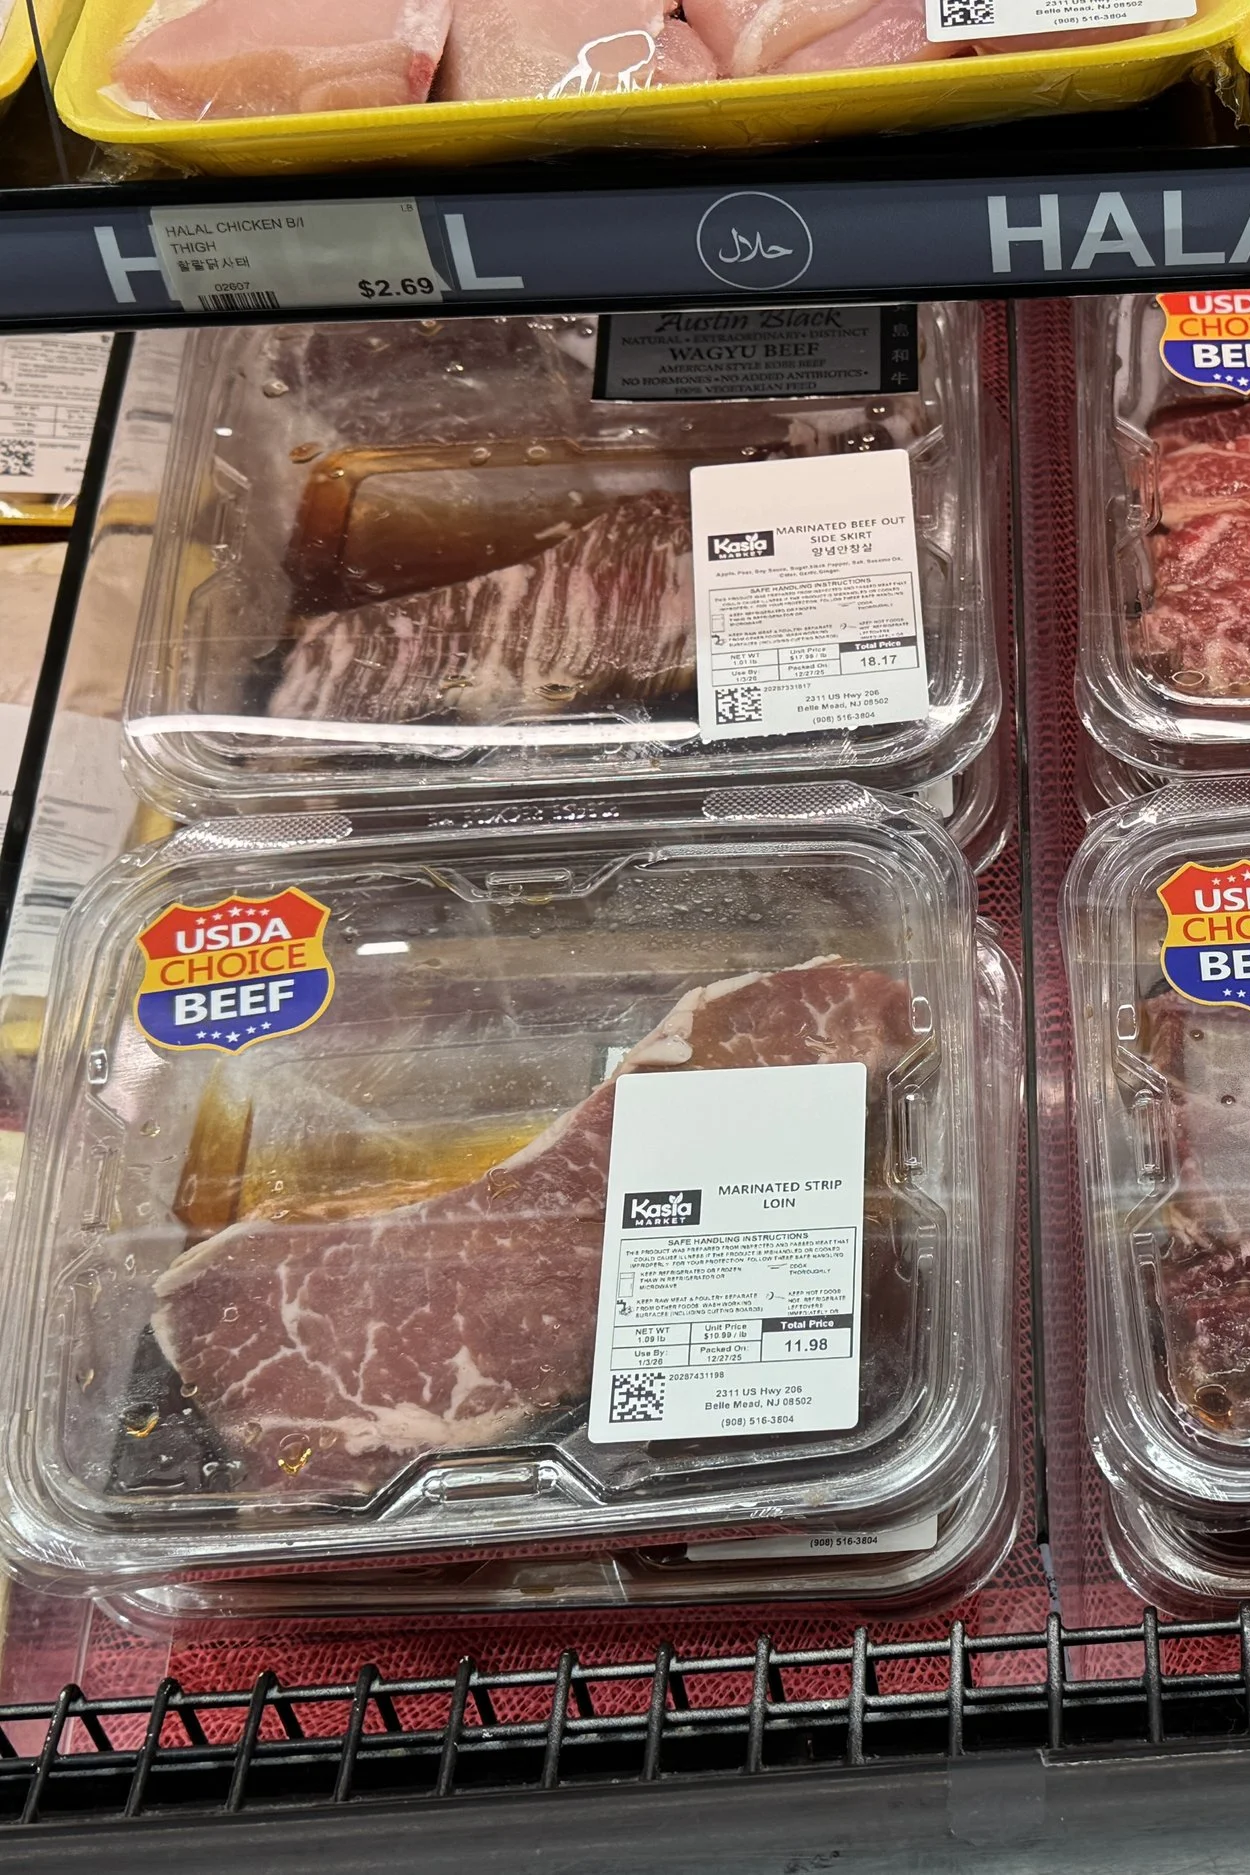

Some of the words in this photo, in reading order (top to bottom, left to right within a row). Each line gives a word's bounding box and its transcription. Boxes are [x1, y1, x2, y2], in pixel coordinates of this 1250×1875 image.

[166, 223, 214, 238] HALAL
[216, 217, 283, 233] CHICKEN
[401, 204, 414, 213] LB
[170, 241, 216, 255] THIGH
[214, 281, 251, 292] 02607
[358, 276, 435, 299] $2.69
[654, 311, 750, 334] Austin
[760, 308, 844, 329] Black
[621, 335, 682, 346] NATURAL
[809, 328, 869, 338] DISTINCT
[669, 346, 757, 363] WAGYU
[764, 342, 820, 357] BEEF
[775, 521, 847, 535] MARINATED
[850, 518, 878, 528] BEEF
[880, 515, 905, 525] OUT
[810, 533, 836, 543] SIDE
[839, 530, 873, 541] SKIRT
[712, 534, 767, 554] Kasia
[854, 641, 878, 651] Total
[878, 639, 901, 649] Price
[859, 654, 897, 667] 18.17
[176, 917, 293, 954] USDA
[160, 943, 307, 986] CHOICE
[174, 979, 295, 1026] BEEF
[717, 1181, 800, 1196] MARINATED
[803, 1179, 842, 1191] STRIP
[630, 1195, 693, 1219] Kasia
[762, 1197, 796, 1209] LOIN
[634, 1216, 686, 1226] MARKET
[667, 1238, 691, 1246] SAFE
[693, 1235, 740, 1245] HANDLING
[742, 1231, 809, 1242] INSTRUCTIONS
[634, 1327, 653, 1335] NET
[655, 1326, 670, 1334] WT
[704, 1323, 724, 1332] Unit
[724, 1322, 747, 1331] Price
[779, 1319, 806, 1330] Total
[808, 1318, 834, 1328] Price
[637, 1335, 655, 1344] 1.09
[656, 1334, 666, 1343] lb
[703, 1331, 732, 1340] $10.99
[738, 1330, 747, 1338] lb
[699, 1344, 733, 1354] Packed
[733, 1344, 750, 1352] On:
[784, 1337, 828, 1353] 11.98
[633, 1349, 651, 1358] Use
[652, 1348, 668, 1358] By:
[706, 1353, 742, 1363] 12/27/25
[637, 1357, 663, 1367] 1/3/26
[715, 1388, 739, 1398] 2311
[741, 1387, 757, 1396] US
[759, 1385, 782, 1396] Hwy
[784, 1384, 803, 1394] 206
[704, 1400, 730, 1410] Belle
[732, 1399, 763, 1409] Mead,
[766, 1398, 780, 1407] NJ
[782, 1396, 812, 1406] 08502
[720, 1417, 746, 1428] (908)
[809, 1537, 834, 1548] (908)
[836, 1536, 878, 1546] 516-3804
